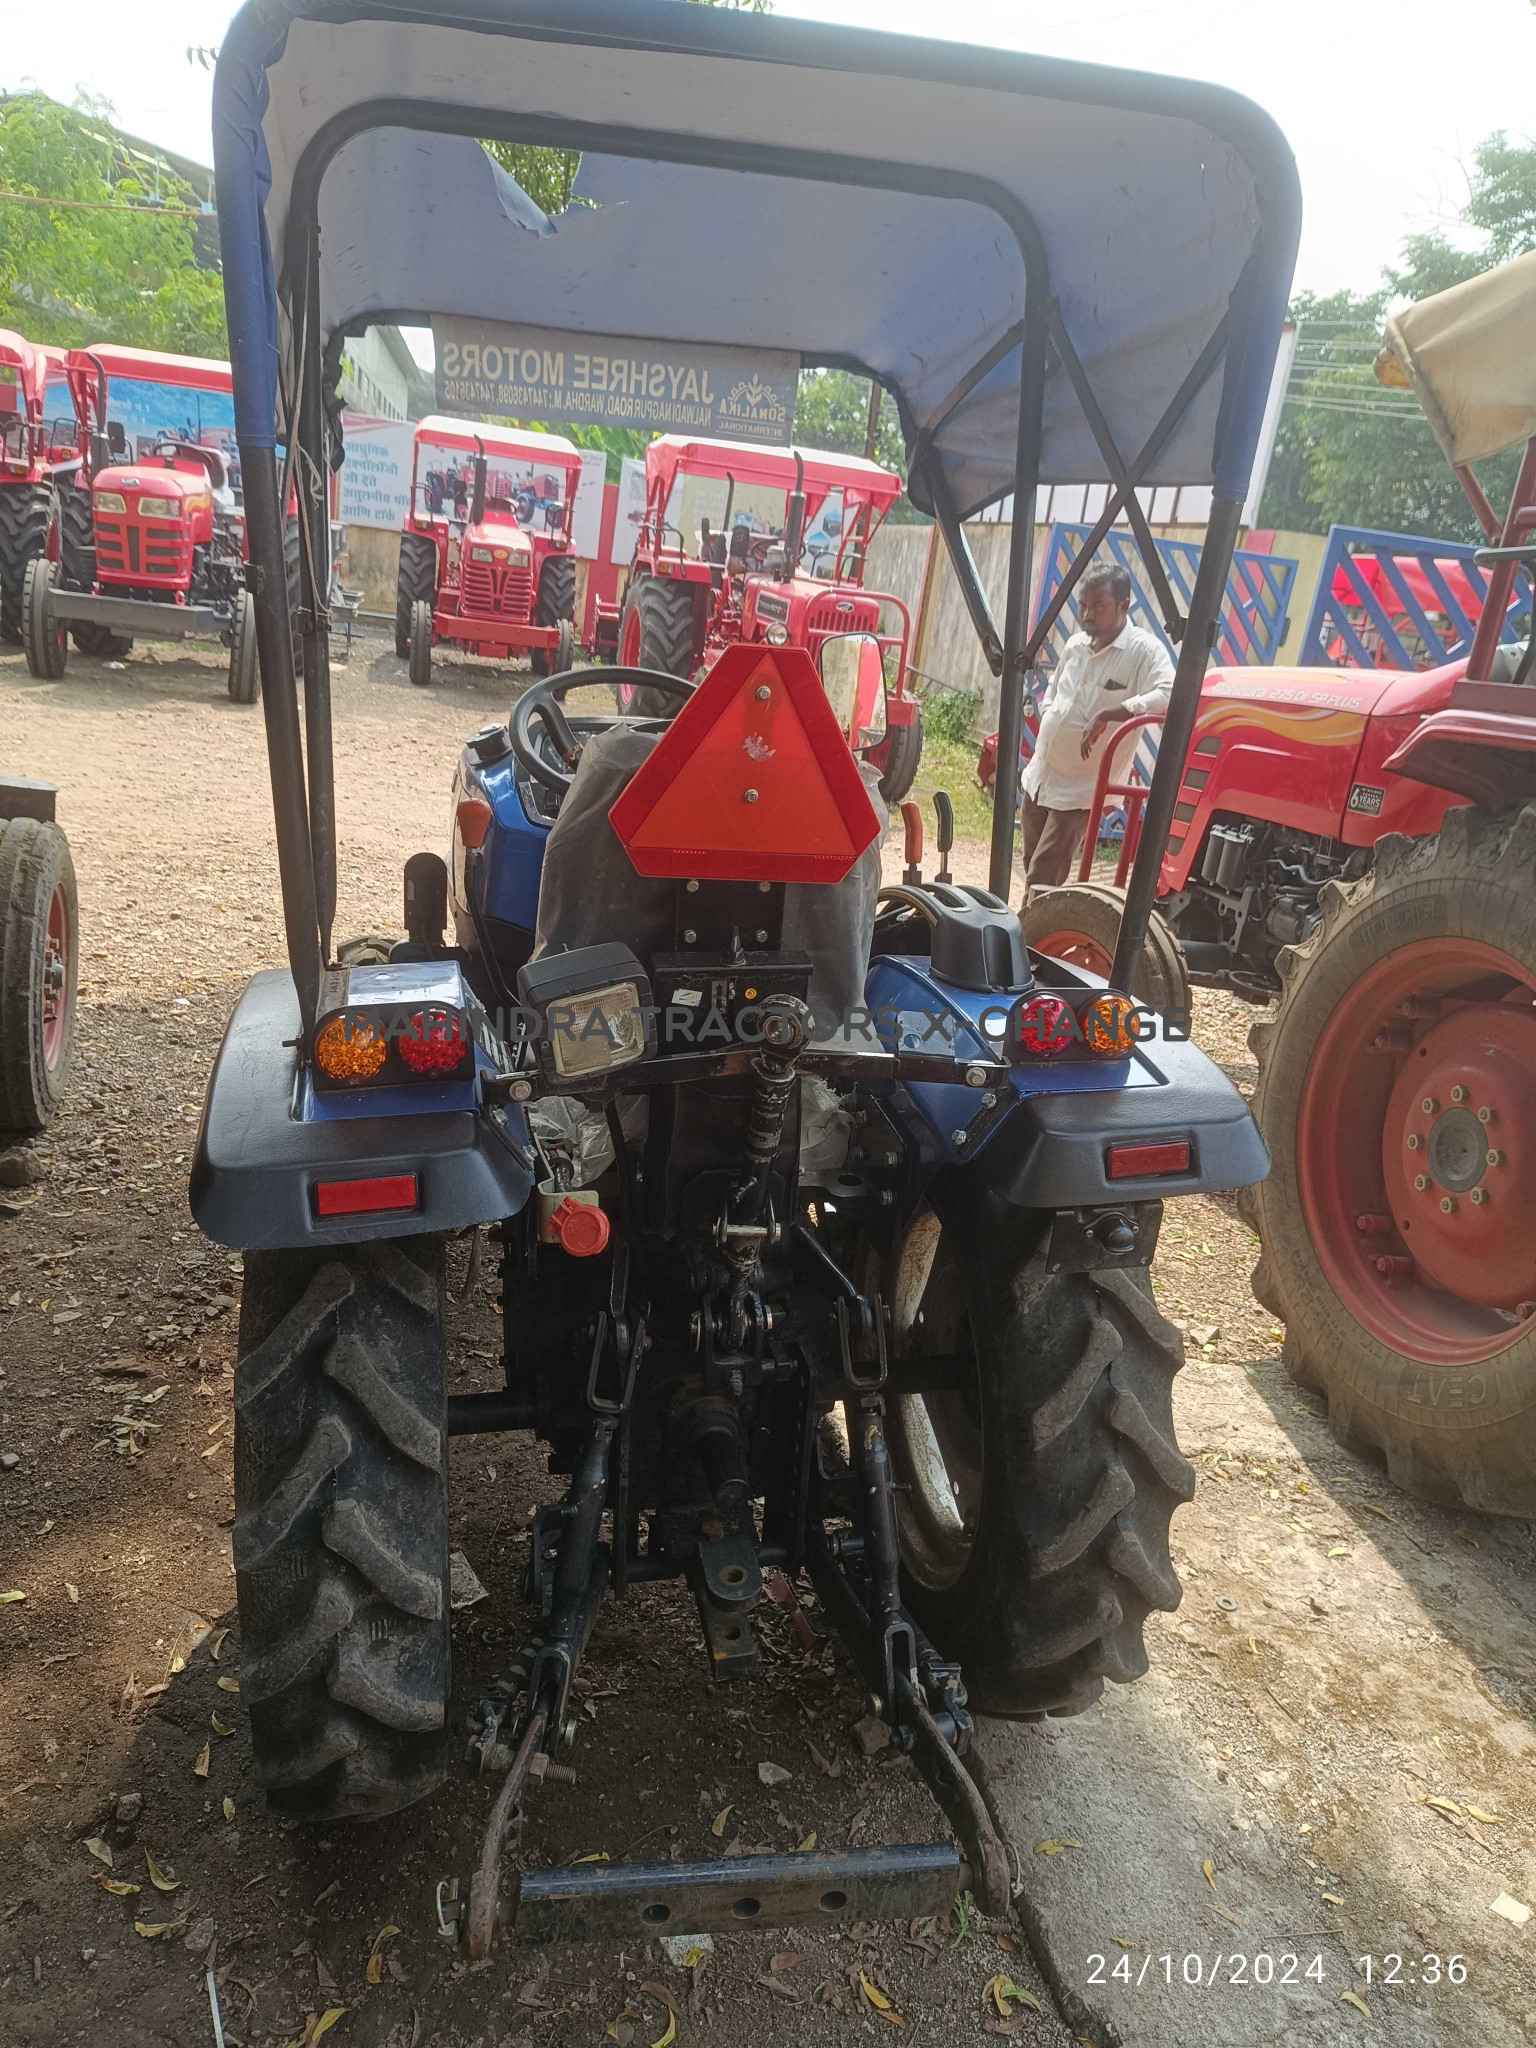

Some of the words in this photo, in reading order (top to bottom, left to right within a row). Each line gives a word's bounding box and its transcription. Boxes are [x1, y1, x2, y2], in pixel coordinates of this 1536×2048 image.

[1269, 689, 1294, 699] 275
[1326, 695, 1362, 709] PLUS
[1350, 788, 1360, 808] 6
[1359, 795, 1381, 808] YEARS
[1406, 1370, 1487, 1407] CEAT
